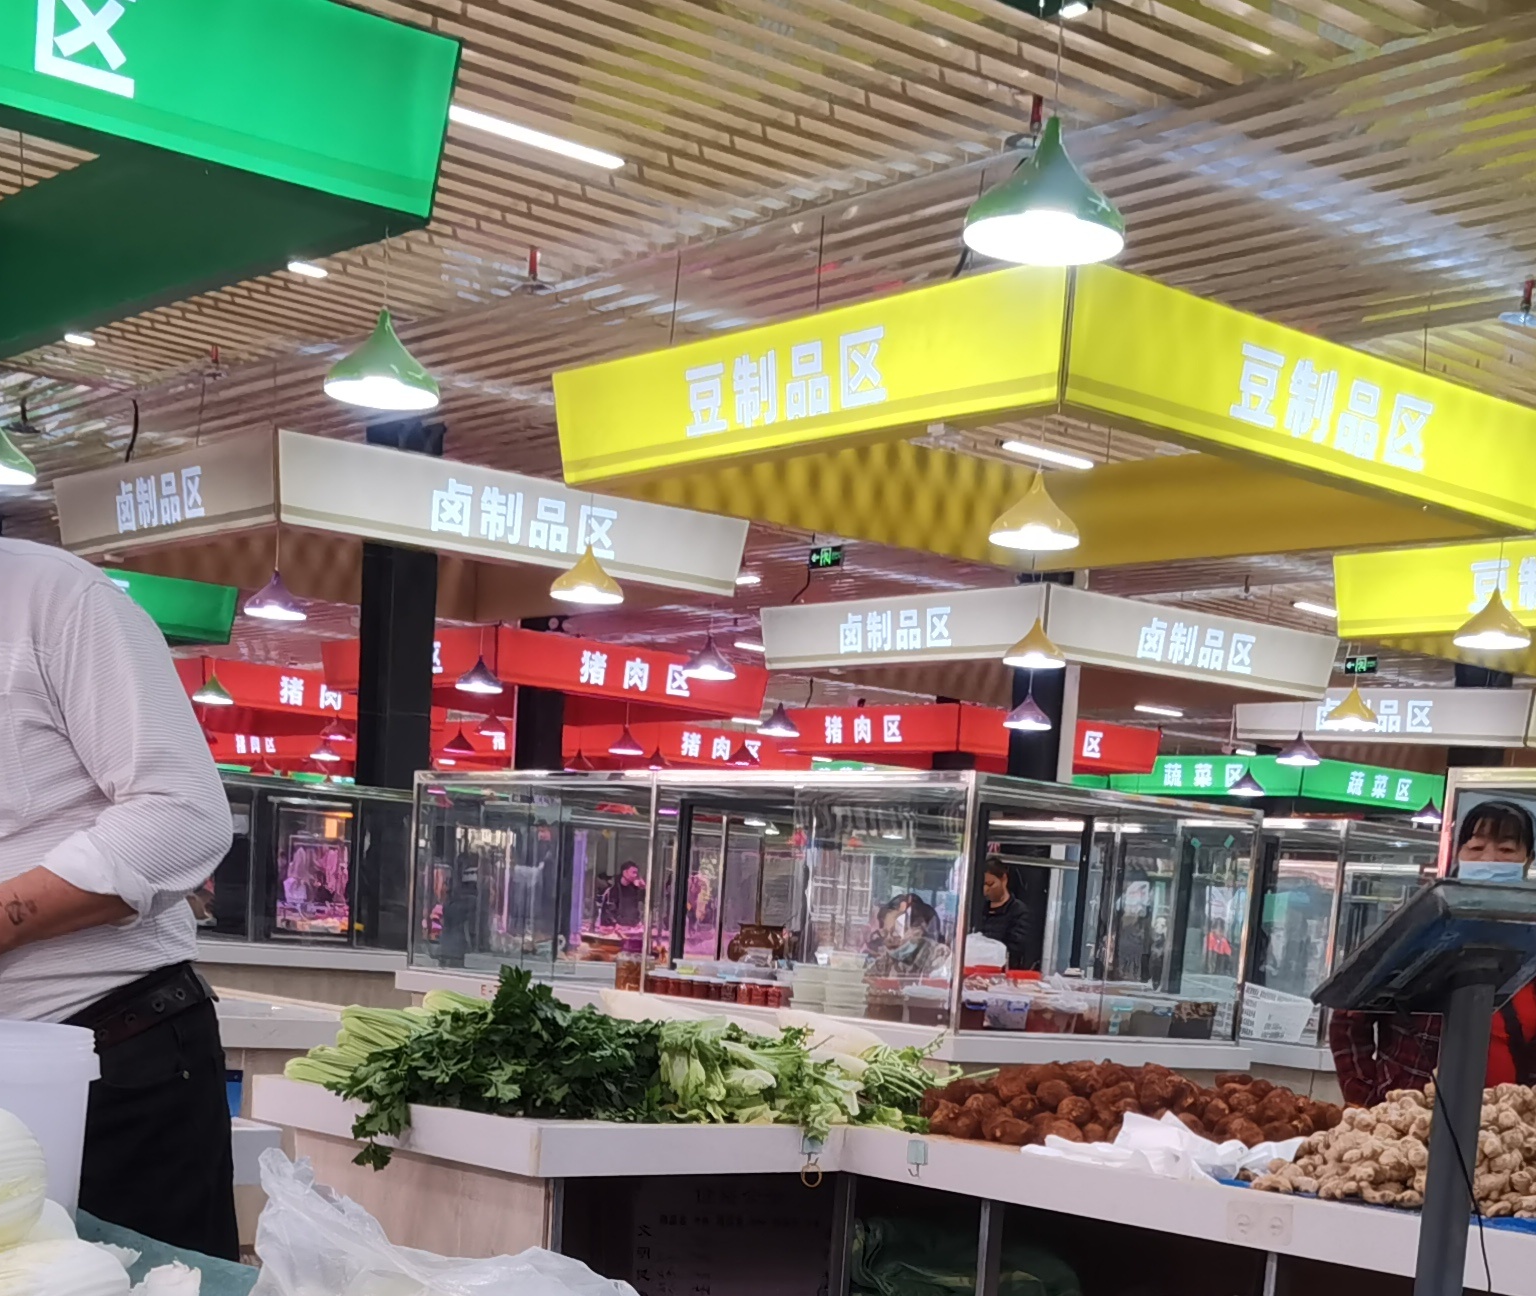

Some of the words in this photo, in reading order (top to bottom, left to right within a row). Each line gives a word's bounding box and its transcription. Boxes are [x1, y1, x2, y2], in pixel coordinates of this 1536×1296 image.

[685, 326, 887, 437] 豆制品区
[1229, 342, 1434, 472] 豆制品区
[115, 466, 205, 533] 卤制品区
[431, 478, 618, 559] 卤制品区
[839, 606, 952, 653] 卤制品区
[1136, 617, 1256, 674] 卤制品区
[580, 650, 690, 697] 猪肉区
[825, 714, 902, 744] 猪肉区
[1346, 770, 1413, 801] 蔬菜区
